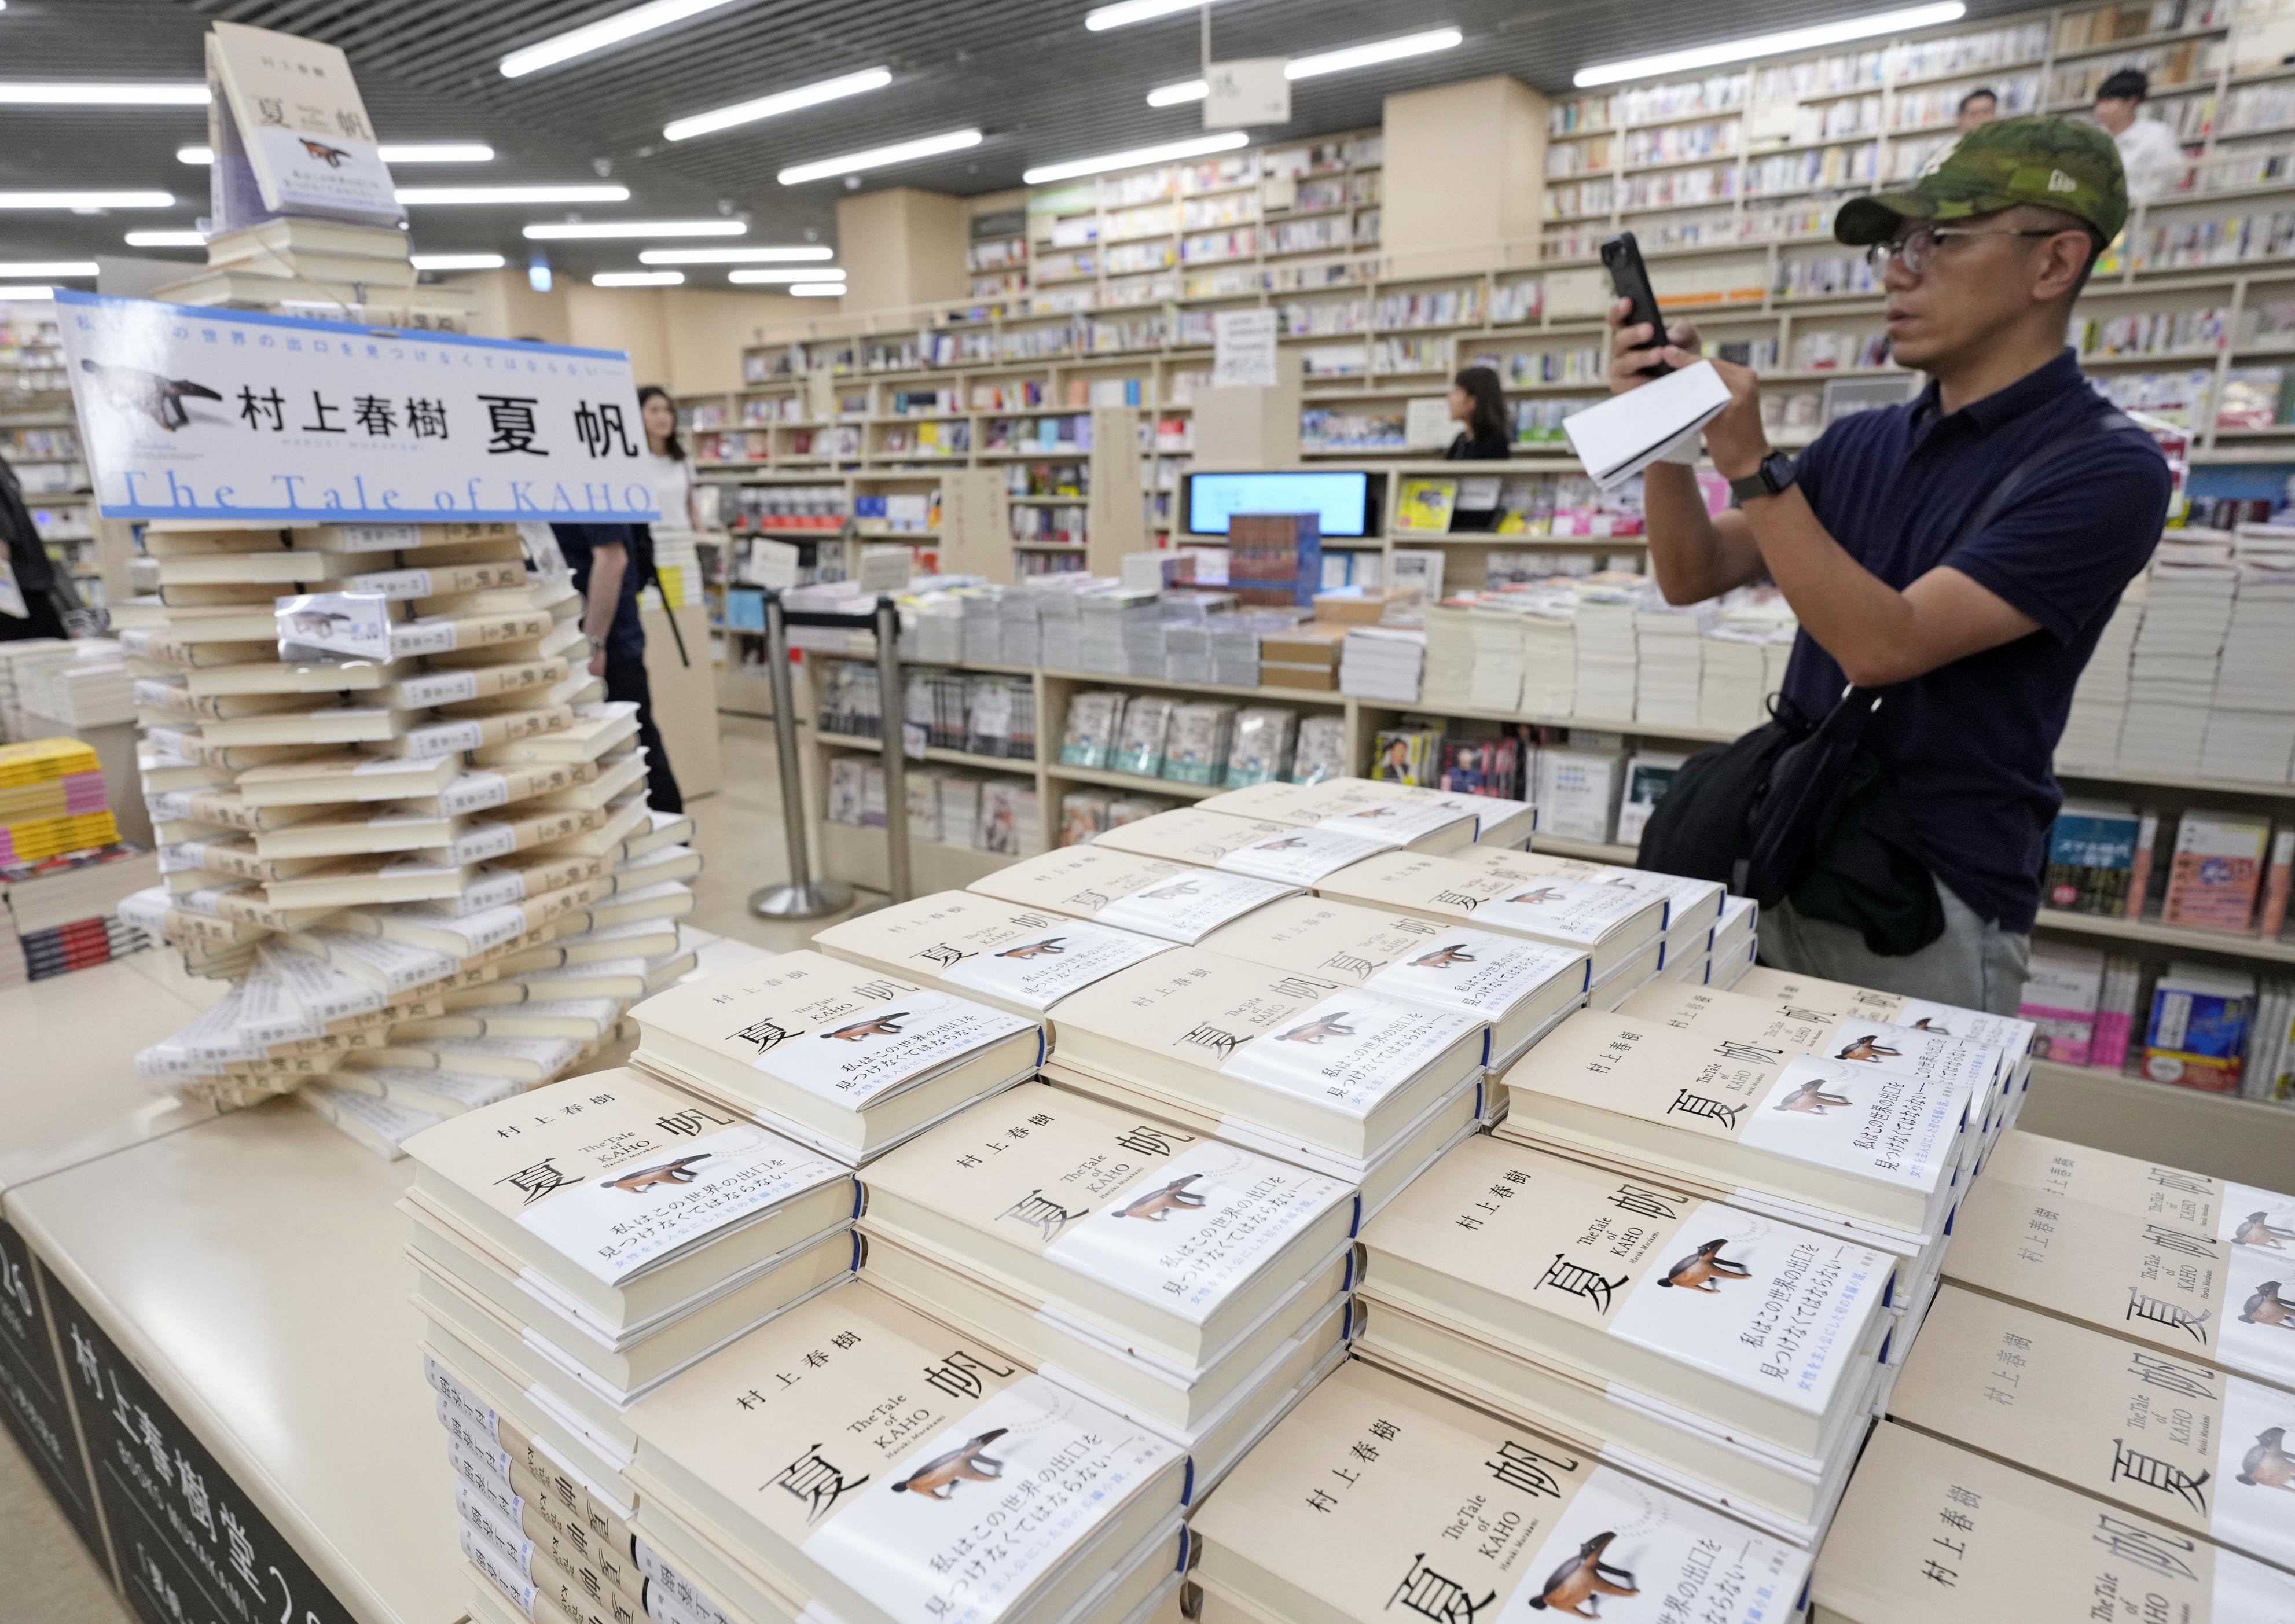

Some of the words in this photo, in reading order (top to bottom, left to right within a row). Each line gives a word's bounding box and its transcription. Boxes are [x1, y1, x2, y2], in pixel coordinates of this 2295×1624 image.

[237, 385, 449, 440] 村上春樹
[477, 395, 549, 457] 夏
[573, 399, 639, 458] 帆
[122, 470, 236, 509] The
[272, 475, 399, 511] Tale
[435, 477, 482, 512] of
[509, 482, 652, 513] KAHO
[887, 906, 967, 933] 村上春樹
[1428, 890, 1490, 912] 夏
[909, 943, 979, 968] 夏
[1009, 912, 1069, 929] 帆
[1317, 951, 1389, 980] 夏
[1394, 916, 1451, 935] 帆
[712, 969, 808, 1005] 村上春樹
[1132, 968, 1212, 1008] 村上春樹
[1455, 945, 1534, 993] 私はこの世界の出口を
[725, 1017, 805, 1055] 夏
[852, 979, 922, 1001] 帆
[791, 1005, 815, 1015] The
[814, 997, 837, 1008] Tale
[810, 1004, 853, 1020] KAHO
[1173, 1021, 1254, 1061] 夏
[1269, 976, 1339, 1000] 帆
[1225, 1008, 1243, 1016] The
[1242, 997, 1263, 1008] Tale
[1248, 1004, 1285, 1024] KAHO
[840, 1014, 978, 1072] 私はこの世界の出口を
[1321, 1012, 1424, 1079] 私はこの世界の出口を
[1586, 1031, 1642, 1074] 村上春樹
[1667, 1088, 1747, 1129] 夏
[1714, 1041, 1783, 1066] 帆
[1696, 1073, 1713, 1083] The
[1703, 1063, 1722, 1075] Tale
[1726, 1070, 1751, 1092] KAHO
[495, 1093, 615, 1139] 村上春樹
[1853, 1082, 1905, 1150] 私はこの世界の出口を
[493, 1158, 585, 1206] 夏
[656, 1108, 735, 1137] 帆
[579, 1142, 605, 1153] The
[603, 1131, 636, 1145] Tale
[596, 1141, 649, 1163] KAHO
[603, 1157, 627, 1169] Haruki
[629, 1144, 663, 1160] Murakami
[610, 1142, 623, 1150] of
[956, 1113, 1055, 1169] 村上春樹
[995, 1189, 1089, 1242] 夏
[1115, 1125, 1195, 1157] 帆
[1060, 1169, 1082, 1183] The
[1079, 1154, 1106, 1171] Tale
[1086, 1164, 1129, 1193] KAHO
[1092, 1167, 1104, 1177] of
[1099, 1184, 1121, 1199] Haruki
[1119, 1166, 1144, 1185] Murakami
[2147, 1167, 2214, 1195] 帆
[609, 1159, 786, 1236] 私はこの世界の出口を
[1456, 1169, 1531, 1231] 村上春樹
[1162, 1176, 1286, 1270] 私はこの世界の出口を
[1577, 1232, 1598, 1245] The
[1589, 1217, 1612, 1233] Tale
[1607, 1230, 1618, 1240] of
[1610, 1227, 1643, 1257] KAHO
[2017, 1207, 2059, 1262] 村上春樹
[2142, 1224, 2219, 1259] 帆
[1534, 1254, 1630, 1316] 夏
[1607, 1184, 1689, 1220] 帆
[1628, 1249, 1644, 1265] Haruki
[1641, 1231, 1660, 1251] Murakami
[2144, 1254, 2161, 1269] Tale
[2140, 1267, 2157, 1280] The
[2161, 1266, 2175, 1276] of
[2177, 1264, 2197, 1292] KAHO
[1740, 1244, 1820, 1349] 私はこの世界の出口を
[2125, 1286, 2212, 1345] 夏
[737, 1330, 862, 1412] 村上春樹
[1985, 1332, 2033, 1406] 村上春樹
[2128, 1352, 2217, 1400] 帆
[439, 1376, 487, 1430] 村上春樹
[847, 1414, 879, 1433] The
[872, 1394, 907, 1416] Tale
[884, 1412, 898, 1427] of
[2127, 1412, 2146, 1430] The
[2130, 1394, 2150, 1413] Tale
[2151, 1411, 2167, 1424] of
[451, 1417, 497, 1473] 村上春樹
[758, 1443, 870, 1526] 夏
[923, 1350, 1016, 1399] 帆
[873, 1409, 929, 1449] KAHO
[2169, 1408, 2193, 1446] KAHO
[71, 1322, 266, 1603] 村上春樹堂
[1306, 1418, 1401, 1513] 村上春樹
[2110, 1438, 2210, 1518] 夏
[464, 1460, 510, 1516] 村上春樹
[930, 1433, 1104, 1576] 私はこの世界の出口を
[472, 1506, 518, 1563] 村上春樹
[1385, 1552, 1497, 1624] 夏
[1485, 1440, 1578, 1498] 帆
[1441, 1519, 1469, 1540] The
[1457, 1494, 1486, 1519] Tale
[1477, 1511, 1521, 1559] KAHO
[1478, 1516, 1490, 1533] of
[1922, 1484, 1982, 1587] 村上春樹
[2092, 1513, 2198, 1581] 帆
[476, 1548, 522, 1605] 村上春樹
[2095, 1572, 2118, 1600] Tale
[2091, 1596, 2116, 1622] The
